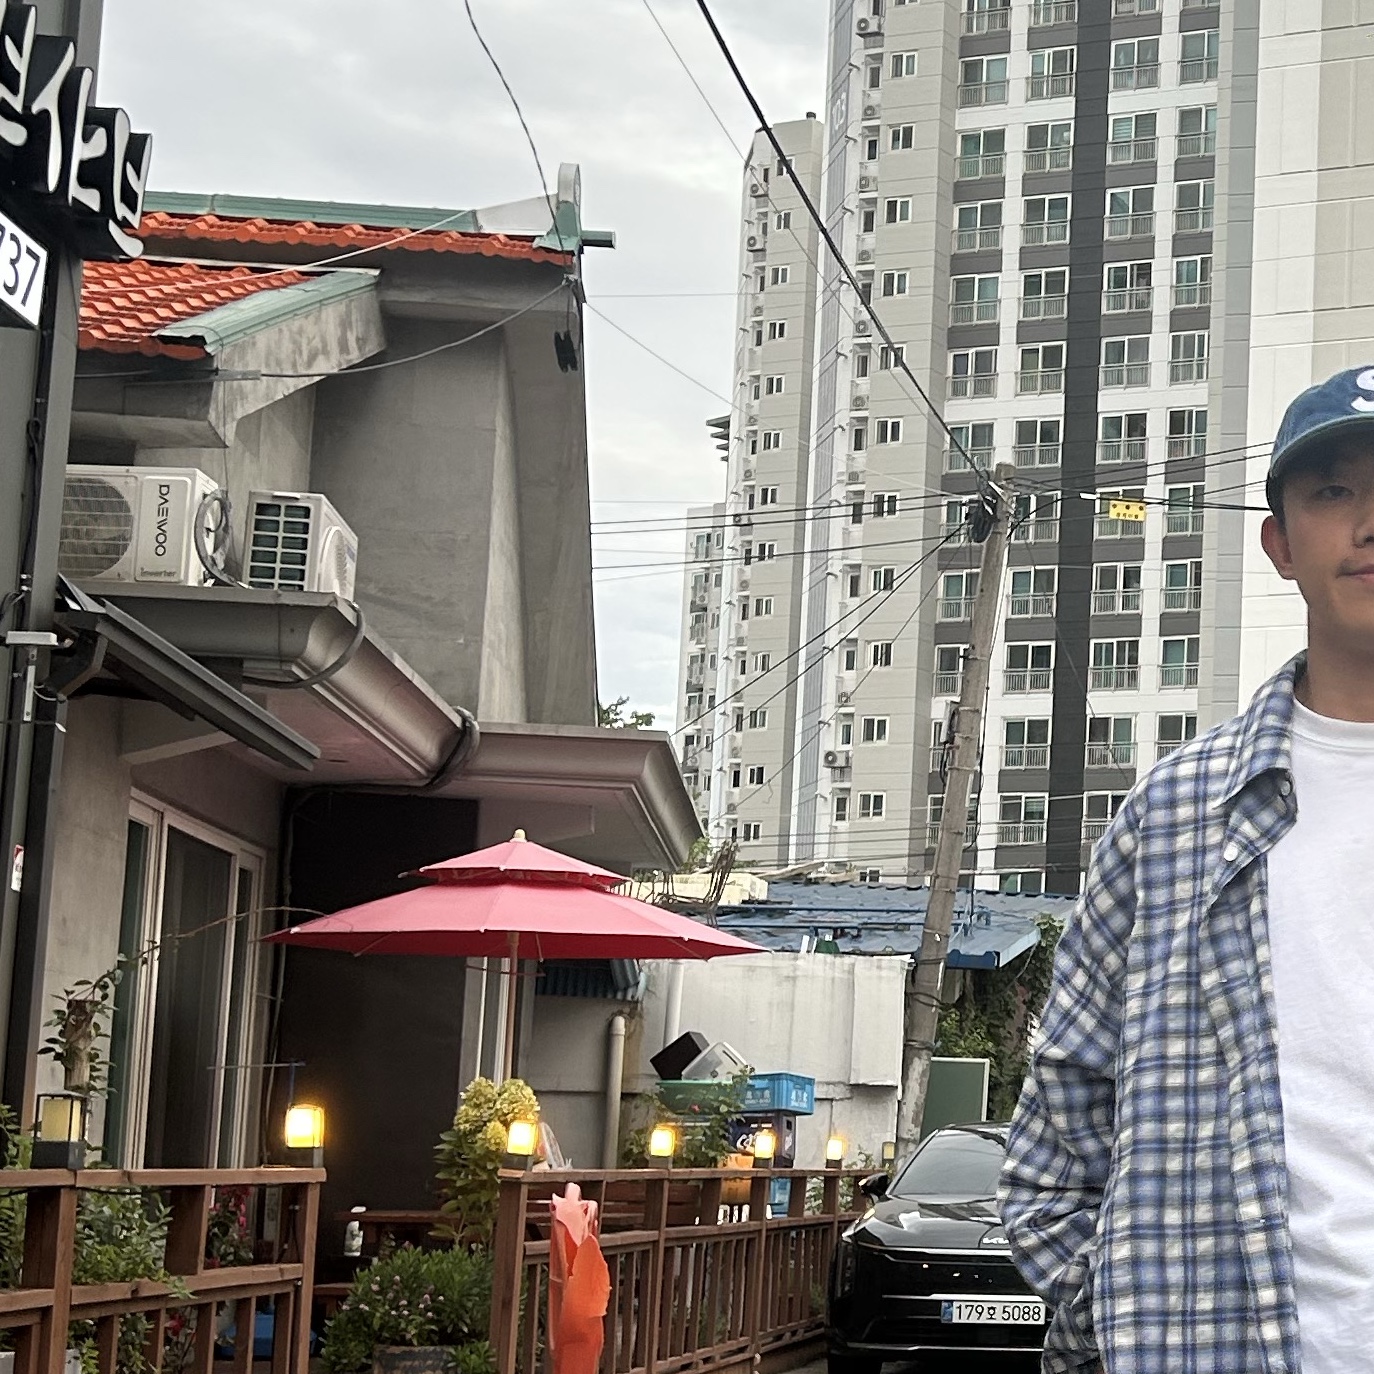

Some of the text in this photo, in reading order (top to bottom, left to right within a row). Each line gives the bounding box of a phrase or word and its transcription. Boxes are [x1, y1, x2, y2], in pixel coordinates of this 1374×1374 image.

[155, 484, 170, 557] DAEWOO
[955, 1304, 1042, 1322] 179호 5088
